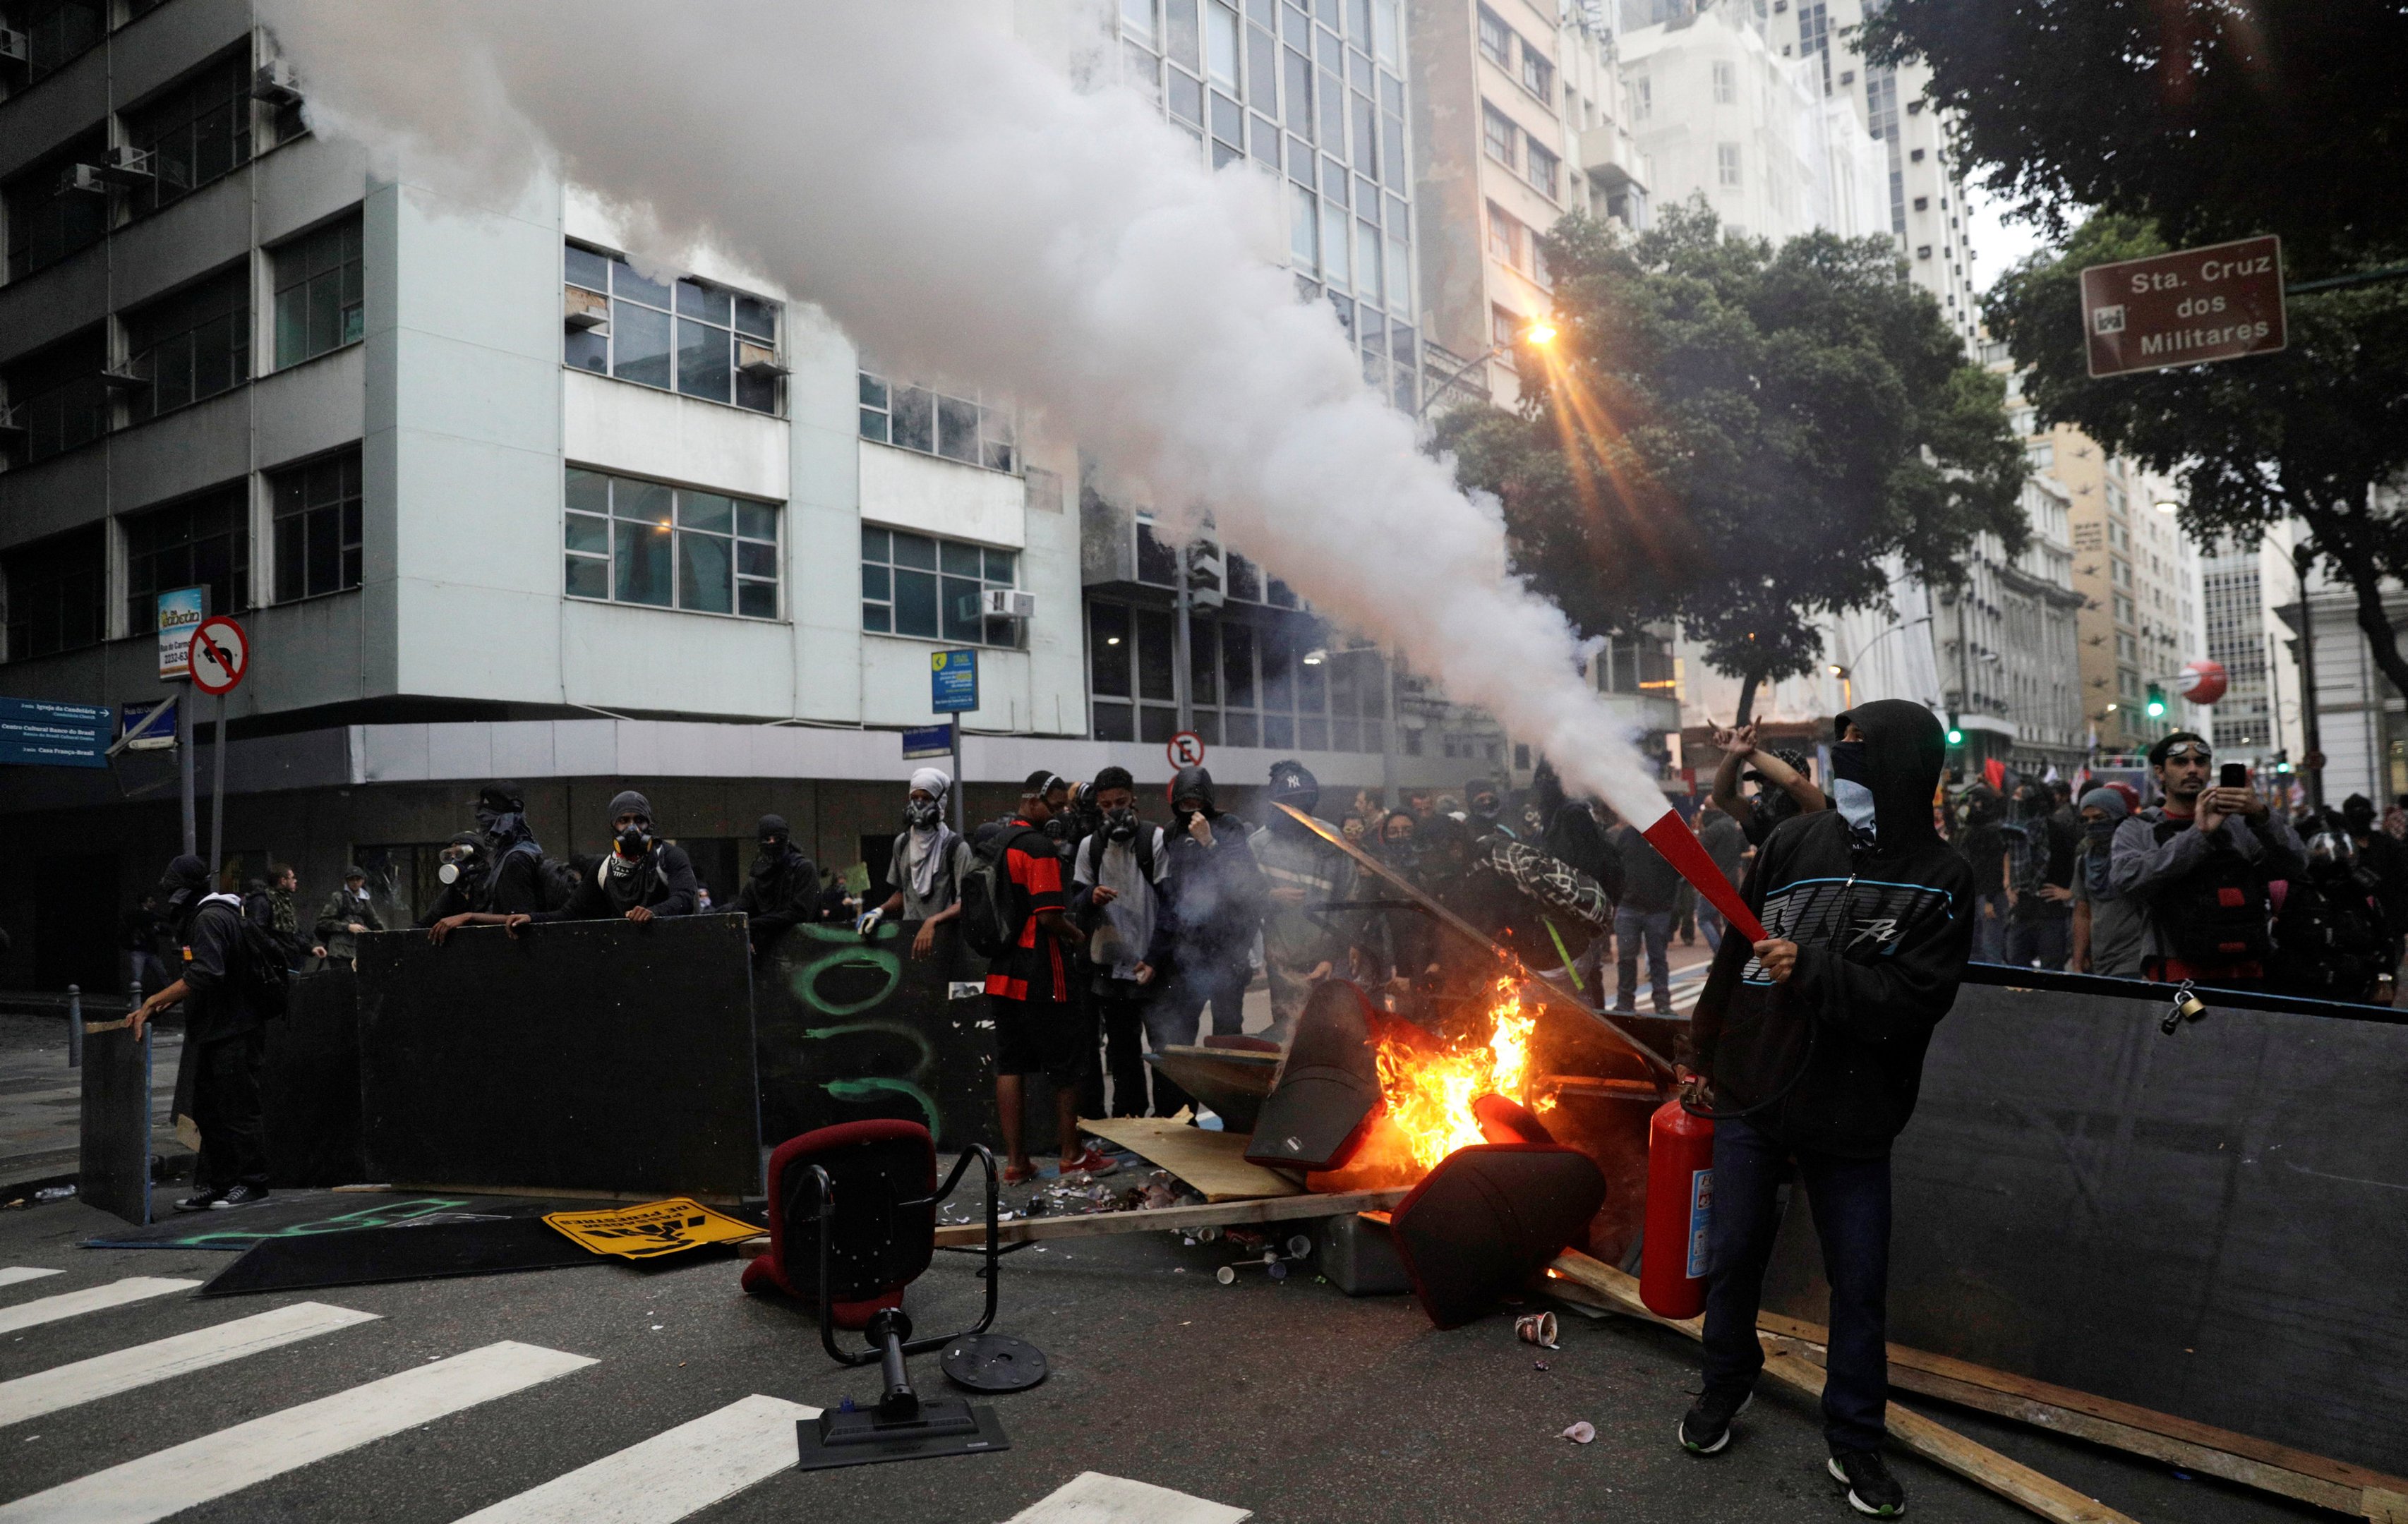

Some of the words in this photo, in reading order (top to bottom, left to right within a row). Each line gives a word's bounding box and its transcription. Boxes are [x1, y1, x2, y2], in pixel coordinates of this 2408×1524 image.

[2131, 272, 2187, 294] Sta.
[2201, 256, 2272, 282] Cruz
[2177, 296, 2226, 319] dos
[2141, 321, 2269, 356] Militares
[164, 651, 188, 664] 2232-63
[664, 1205, 690, 1214] DE
[559, 1211, 663, 1225] PEDESTRES
[582, 1212, 684, 1228] PASSAGEM
